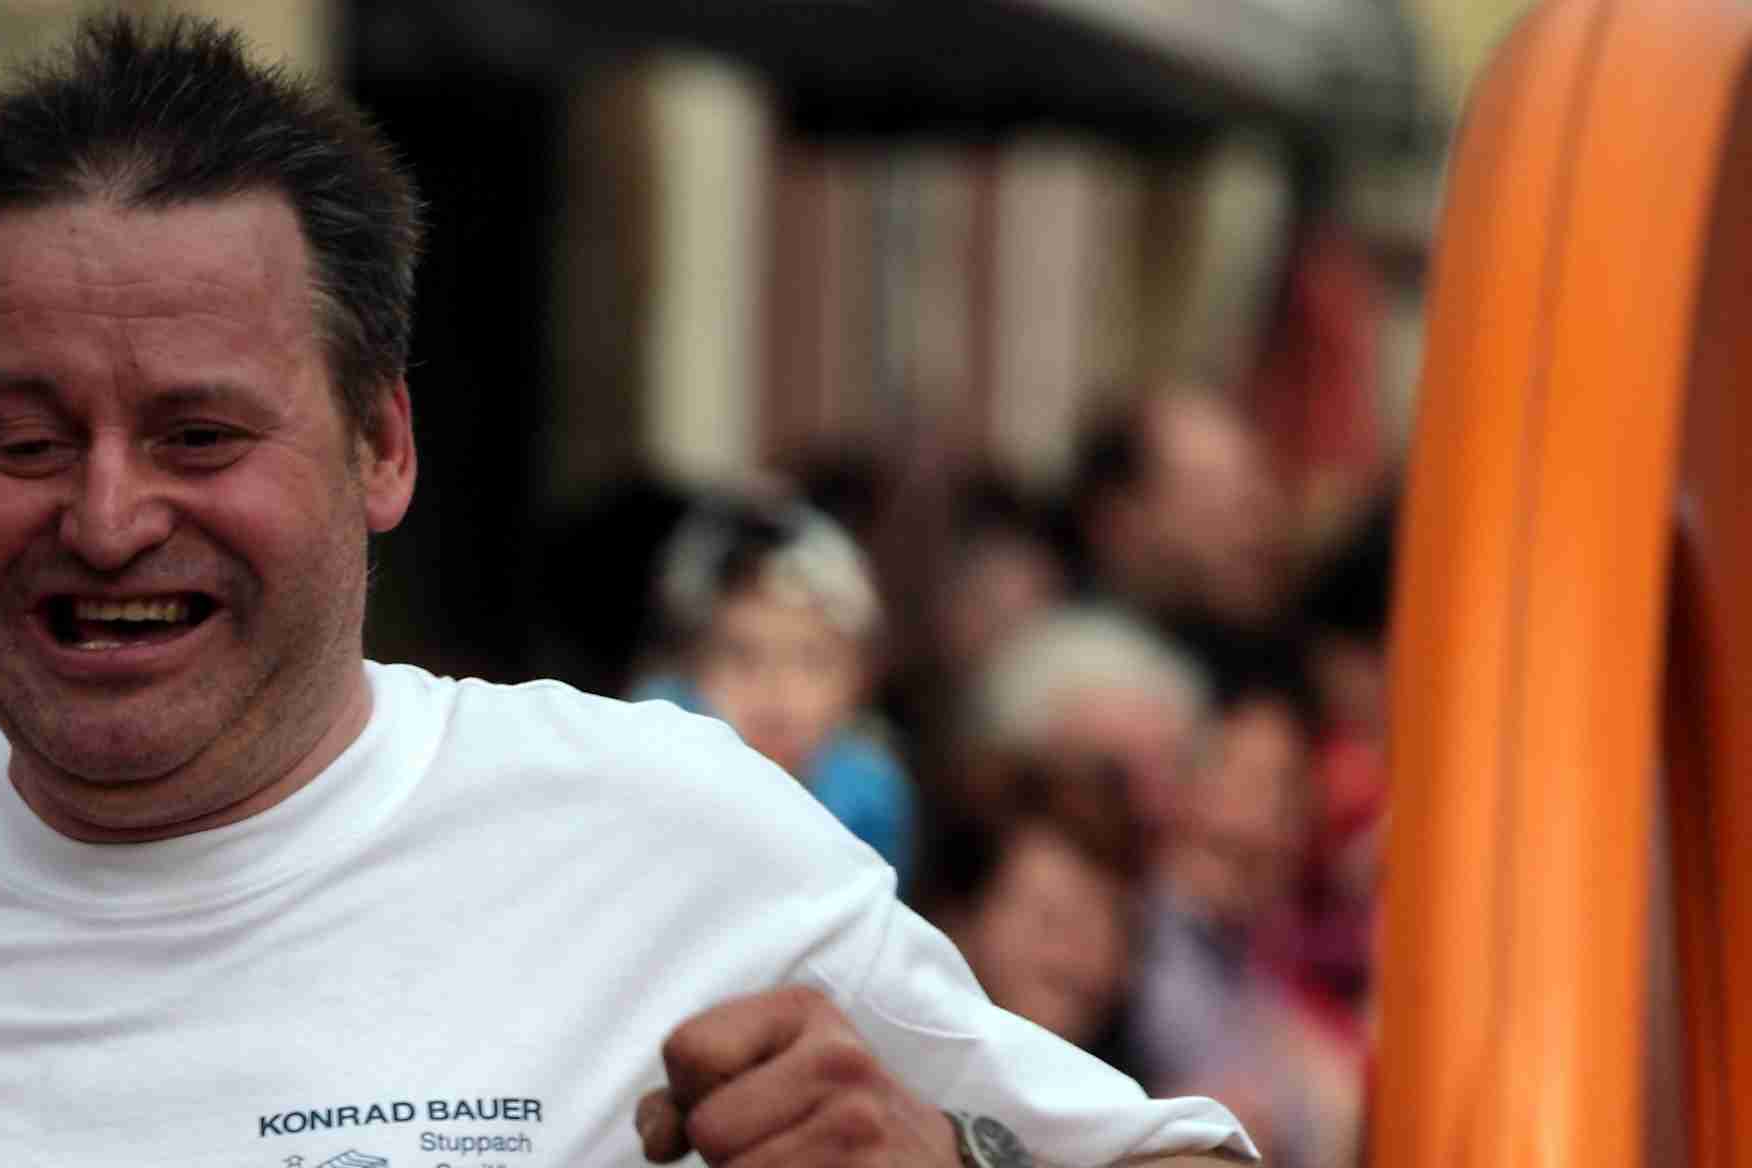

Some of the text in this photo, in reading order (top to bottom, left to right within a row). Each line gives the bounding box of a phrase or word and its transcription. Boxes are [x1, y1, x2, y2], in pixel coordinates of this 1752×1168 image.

[259, 1098, 543, 1137] KONRAD BAUER
[419, 1131, 533, 1155] Stuppach
